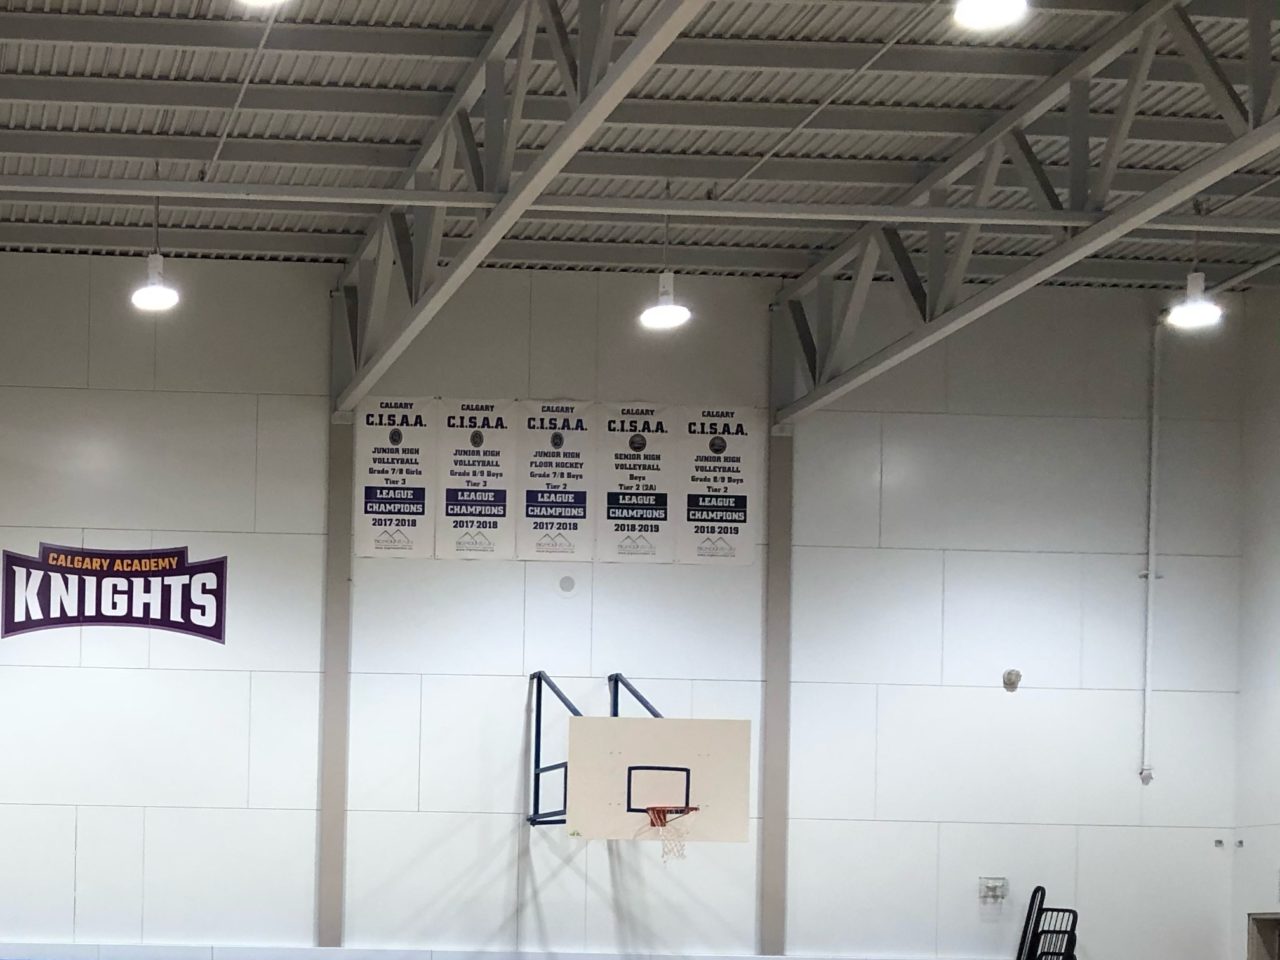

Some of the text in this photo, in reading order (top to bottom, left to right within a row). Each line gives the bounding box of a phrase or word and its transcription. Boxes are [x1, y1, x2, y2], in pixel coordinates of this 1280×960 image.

[461, 404, 494, 412] CALGARY
[366, 414, 426, 427] C.I.S.A.A.
[447, 416, 507, 429] C.I.S.A.A.
[527, 418, 587, 431] C.I.S.A.A.
[608, 420, 668, 433] C.I.S.A.A.
[688, 422, 748, 436] C.I.S.A.A.
[377, 489, 413, 498] LEAGUE
[458, 492, 494, 500] LEAGUE
[538, 493, 574, 502] LEAGUE
[619, 495, 655, 504] LEAGUE
[699, 497, 735, 506] LEAGUE
[367, 503, 422, 512] CHAMPIONS
[448, 505, 503, 514] CHAMPIONS
[528, 506, 584, 516] CHAMPIONS
[610, 509, 665, 518] CHAMPIONS
[690, 511, 744, 520] CHAMPIONS
[372, 518, 416, 527] 2017-2018
[453, 520, 497, 529] 2017-2018
[533, 522, 578, 530] 2017-2018
[614, 524, 659, 532] 2018-2019
[694, 526, 739, 534] 2018-2019
[49, 553, 178, 571] CALGARY ACADEMY
[12, 565, 218, 628] KNIGHTS
